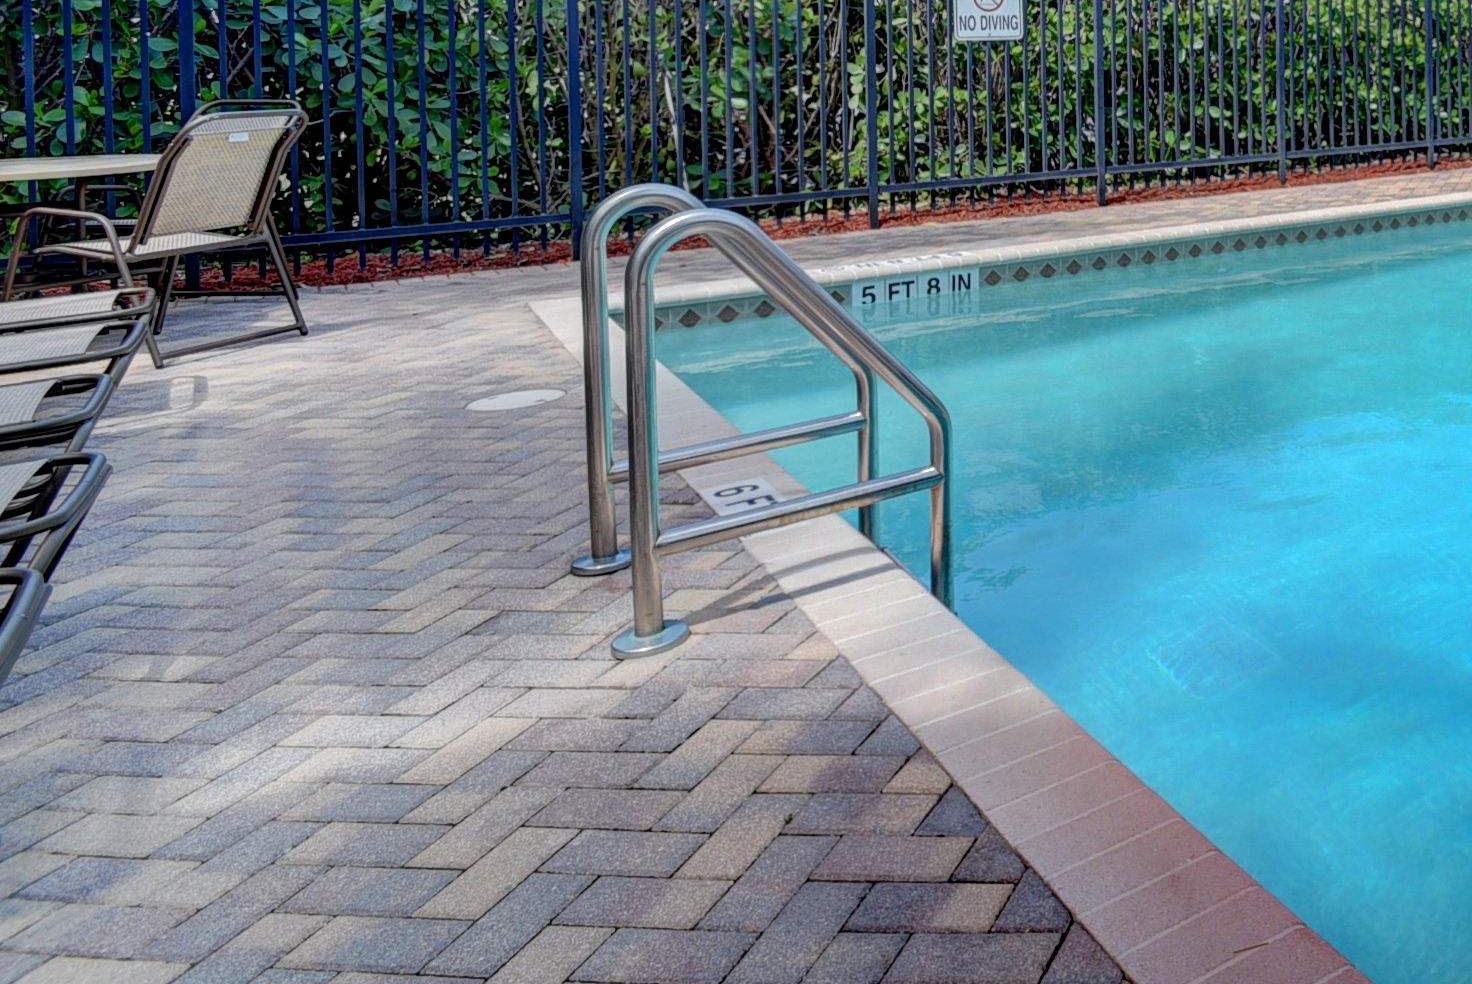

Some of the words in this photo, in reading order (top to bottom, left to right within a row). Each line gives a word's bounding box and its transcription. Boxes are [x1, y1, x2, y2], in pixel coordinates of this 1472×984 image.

[959, 15, 977, 31] NO
[980, 14, 1019, 31] DIVING
[861, 285, 876, 305] 5
[888, 280, 915, 301] FT
[926, 277, 941, 296] 8
[951, 272, 971, 292] IN
